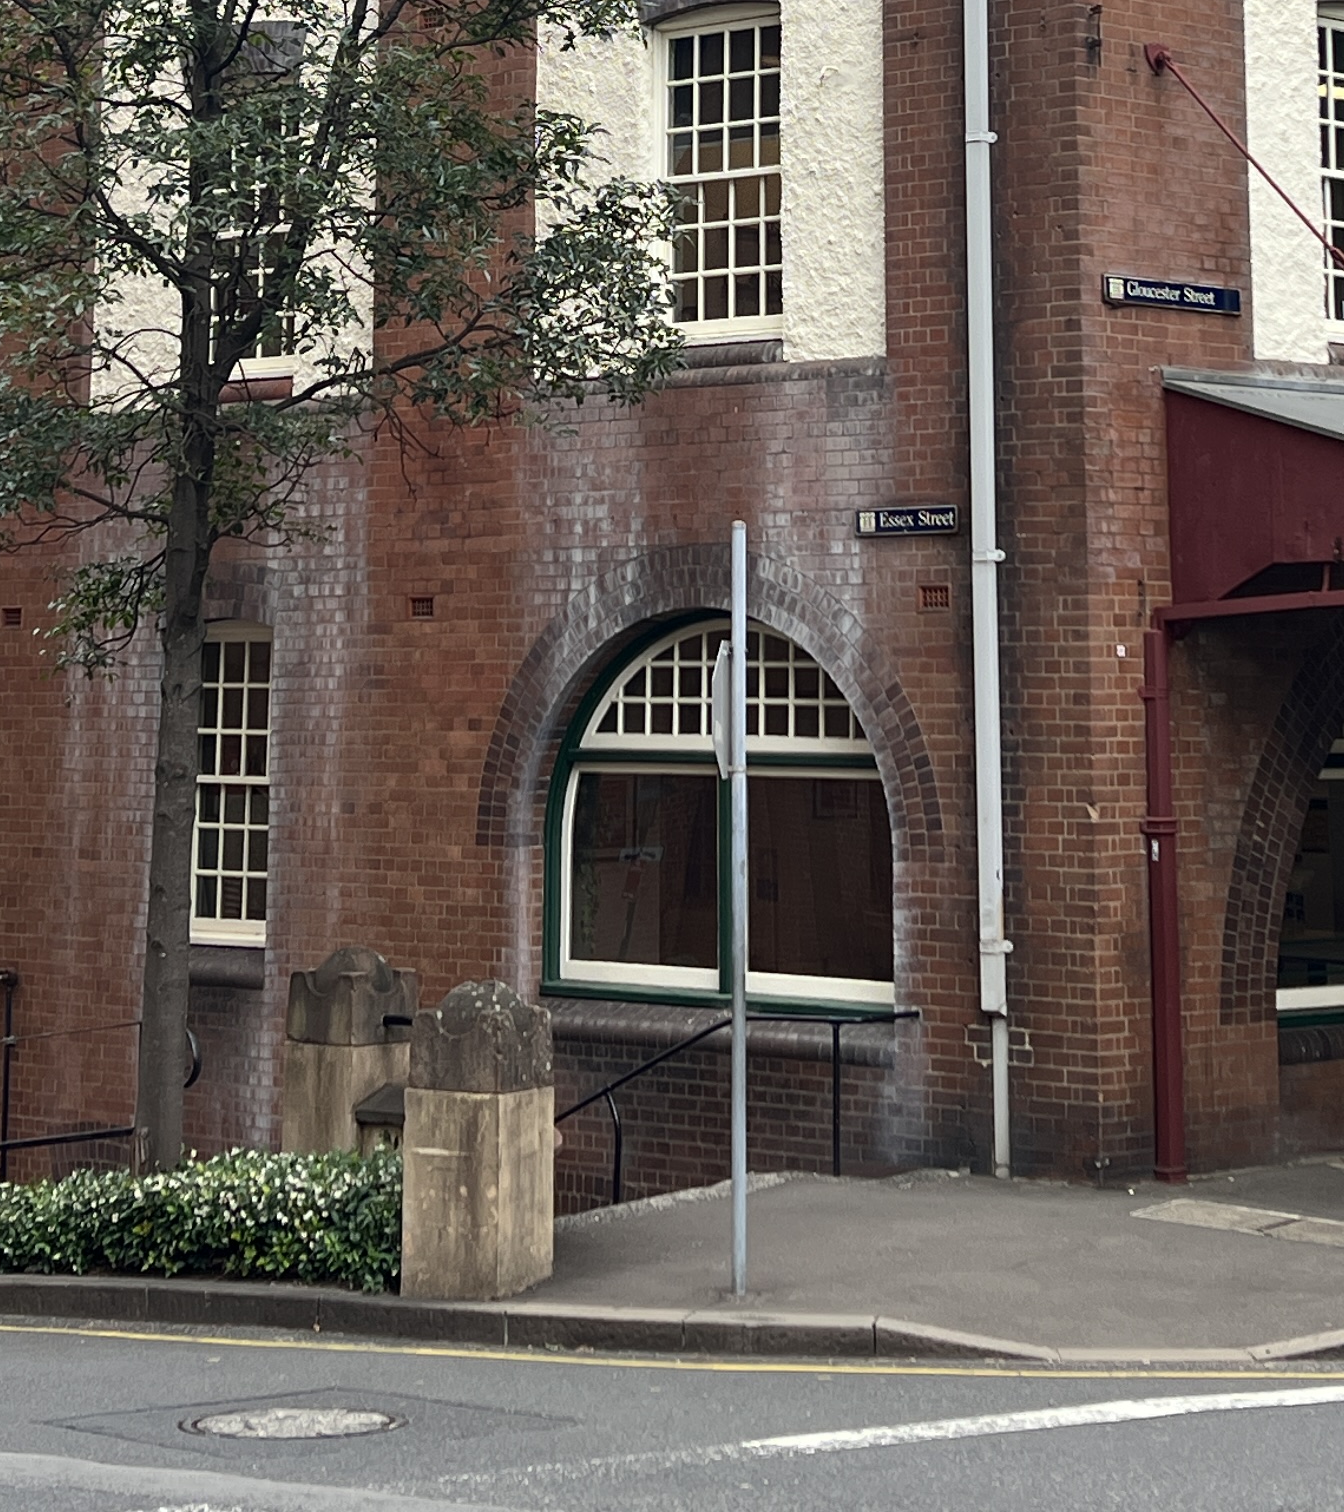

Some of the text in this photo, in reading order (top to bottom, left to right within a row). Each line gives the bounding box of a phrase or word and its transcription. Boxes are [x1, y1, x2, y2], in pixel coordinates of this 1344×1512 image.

[1126, 281, 1215, 306] Gloucester Street
[879, 510, 954, 527] Essex Street
